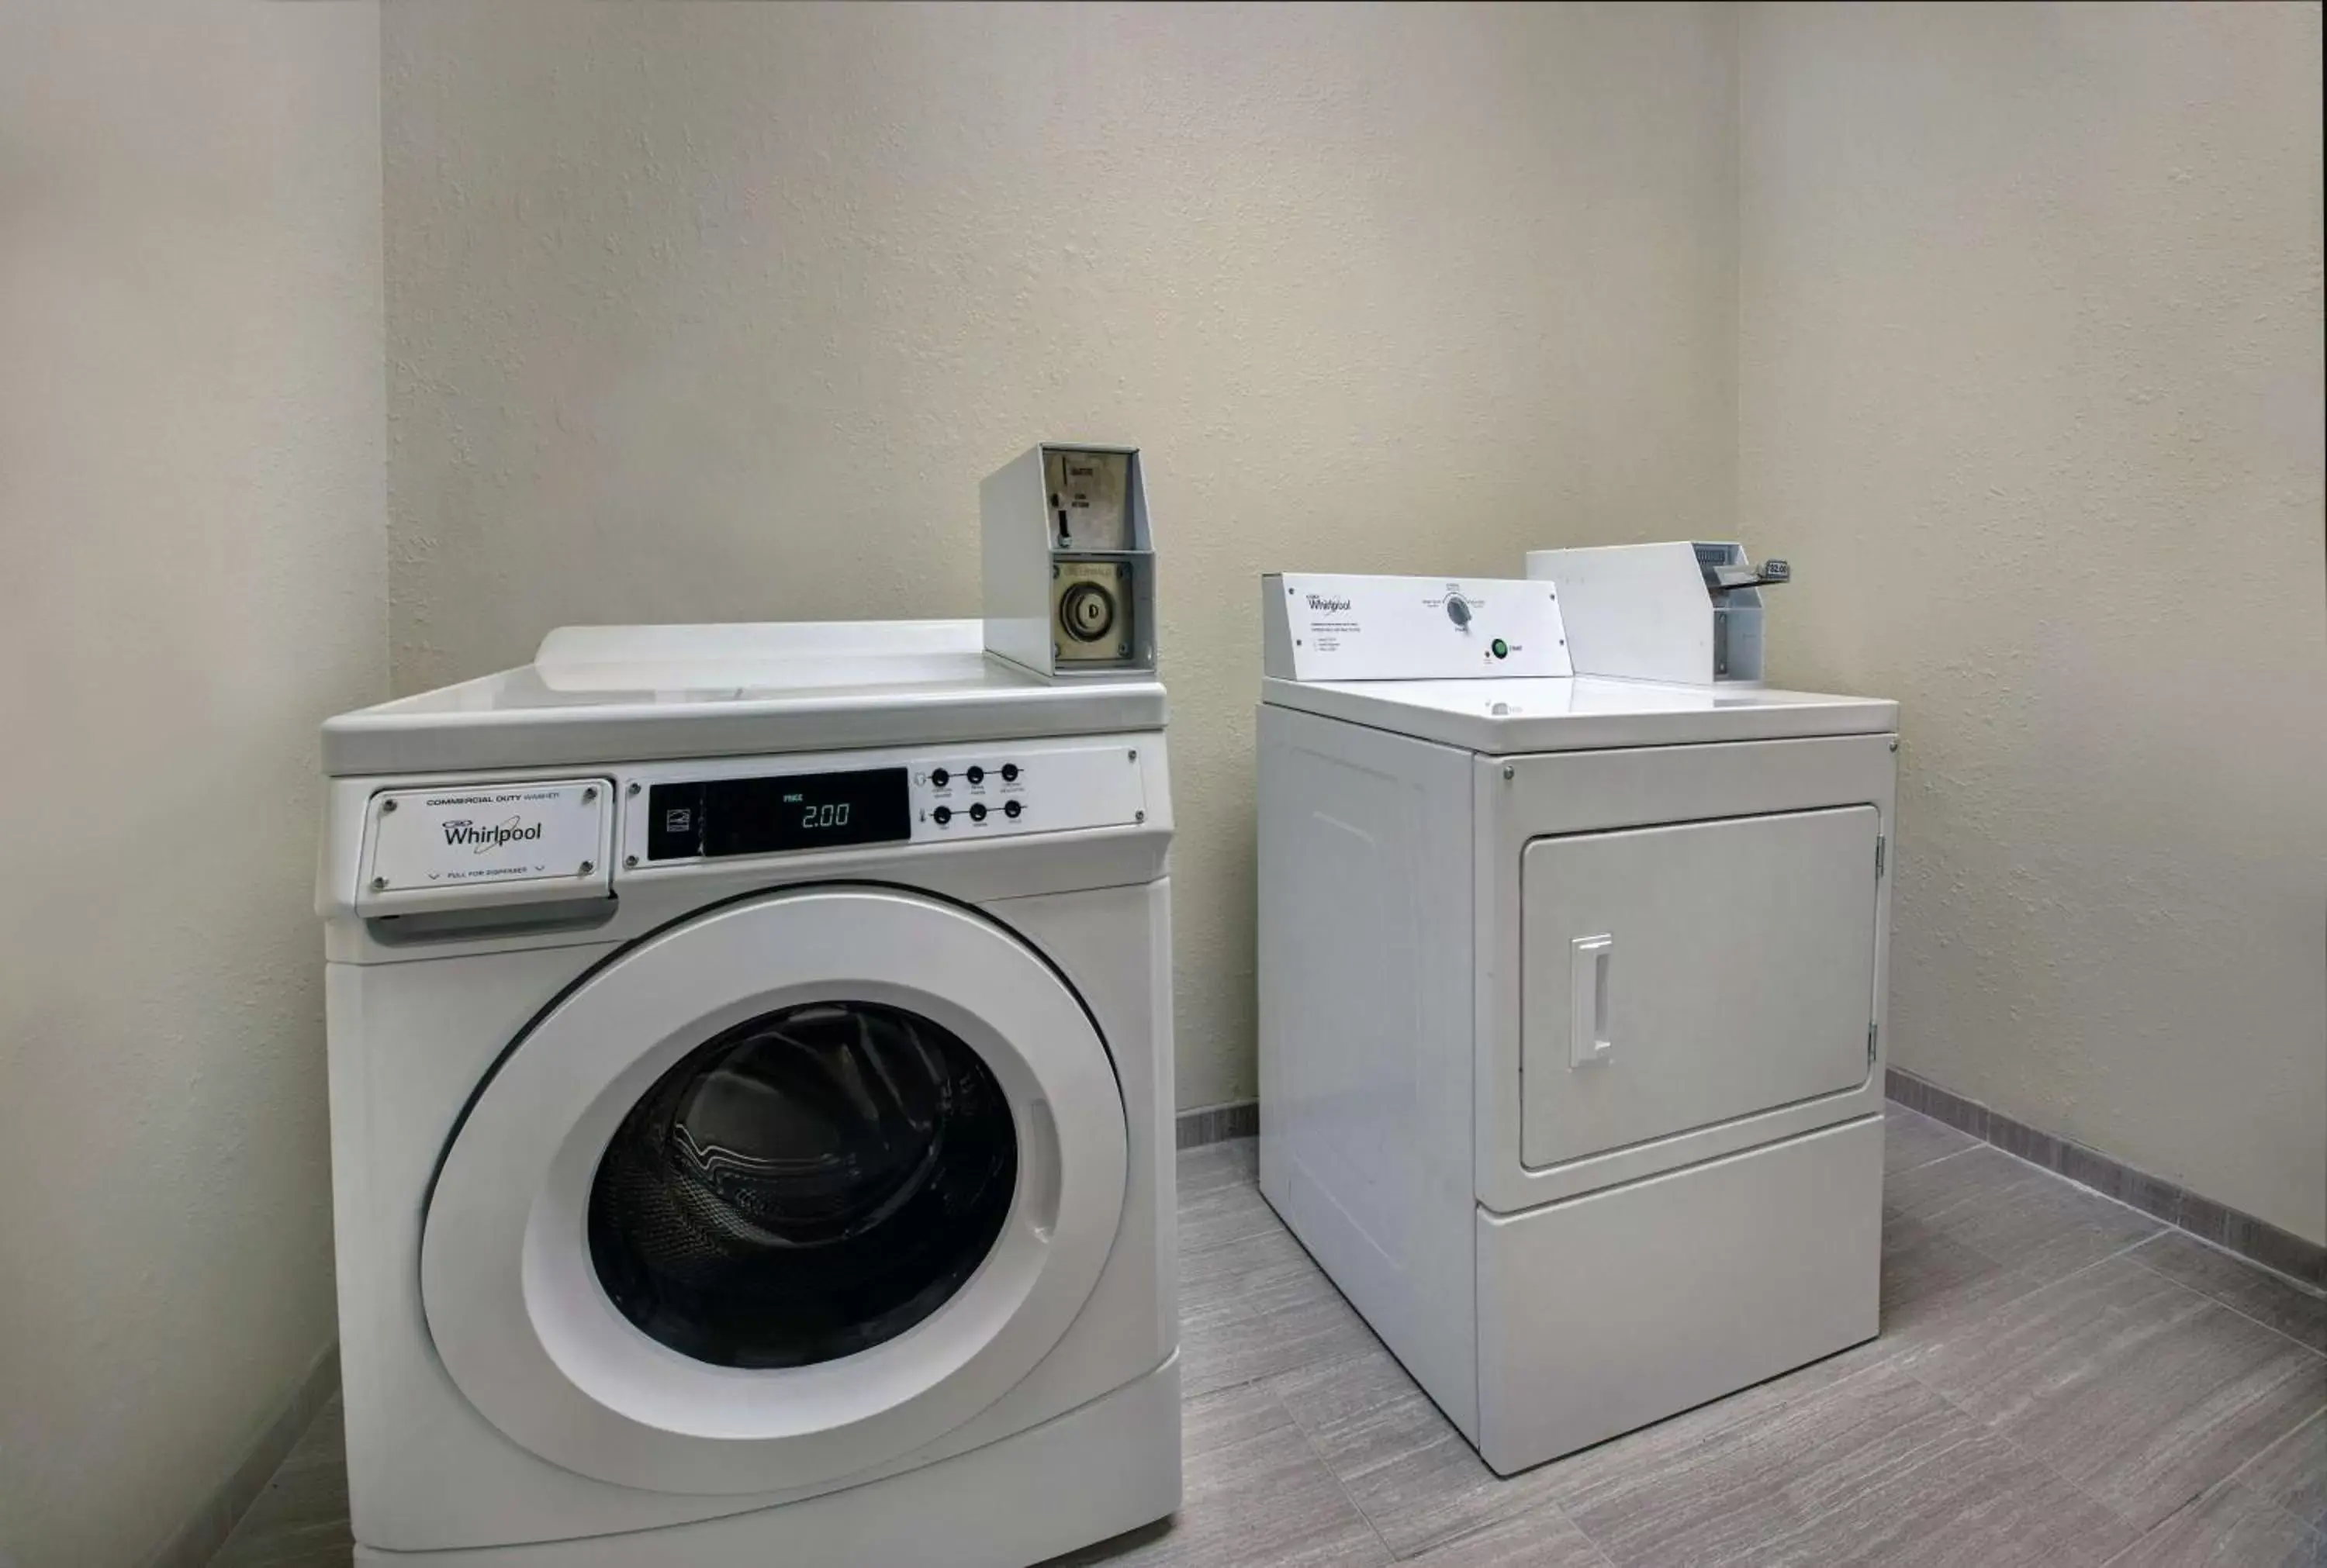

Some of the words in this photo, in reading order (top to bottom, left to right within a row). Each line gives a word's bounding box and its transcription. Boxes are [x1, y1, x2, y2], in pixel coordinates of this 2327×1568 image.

[1309, 598, 1351, 613] Whirlpool
[427, 796, 493, 806] COMMERCIAL
[496, 794, 522, 803] DUTY
[802, 803, 850, 828] 2.00
[445, 822, 541, 847] Whirlpool
